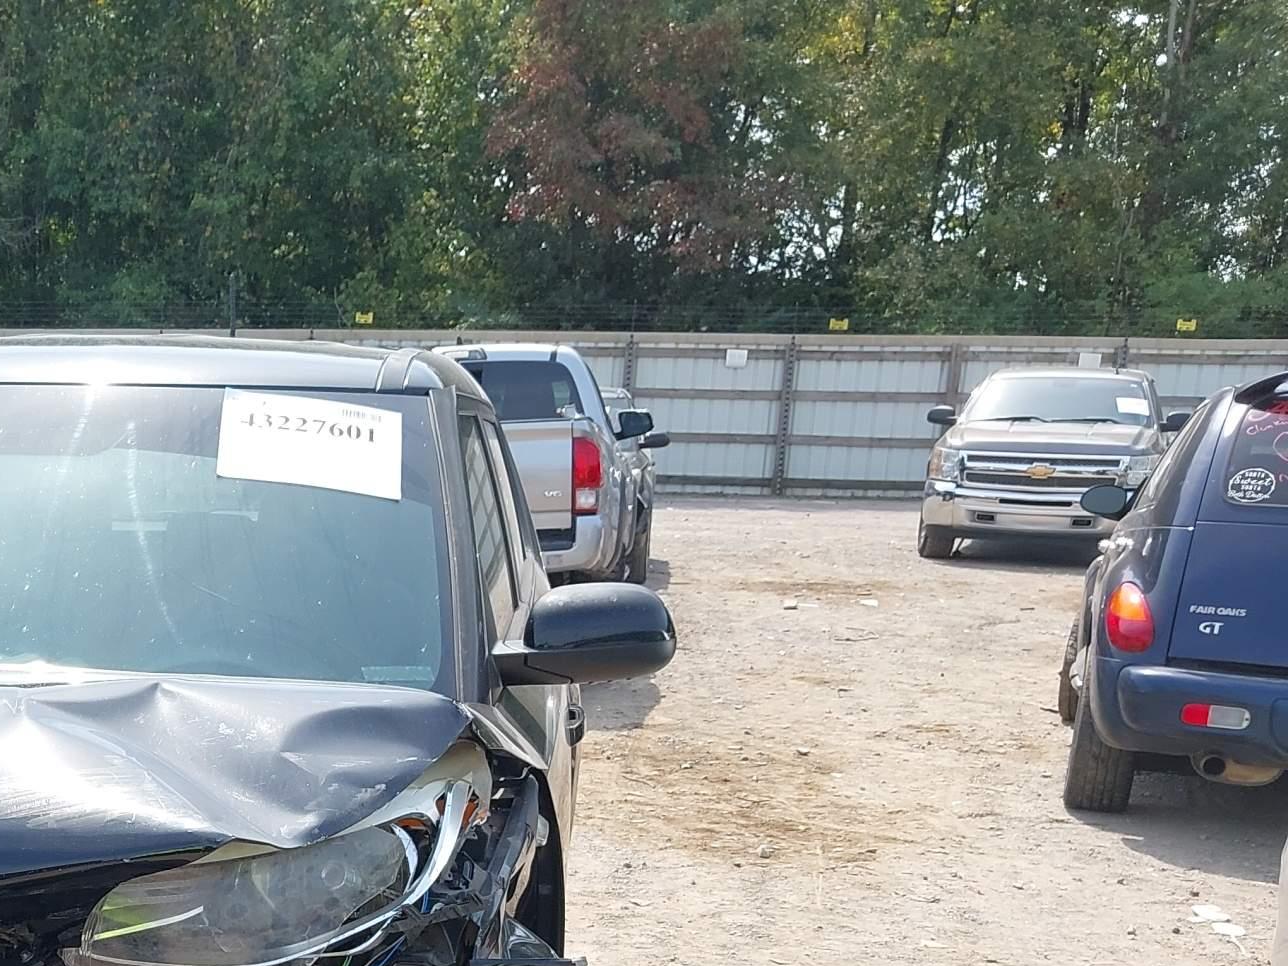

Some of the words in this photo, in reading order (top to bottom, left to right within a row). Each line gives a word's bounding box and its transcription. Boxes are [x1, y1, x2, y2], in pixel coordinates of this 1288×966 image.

[240, 412, 376, 443] 43227601
[1189, 605, 1216, 615] FAIR
[1216, 607, 1247, 617] OAKS
[1198, 621, 1225, 635] GT
